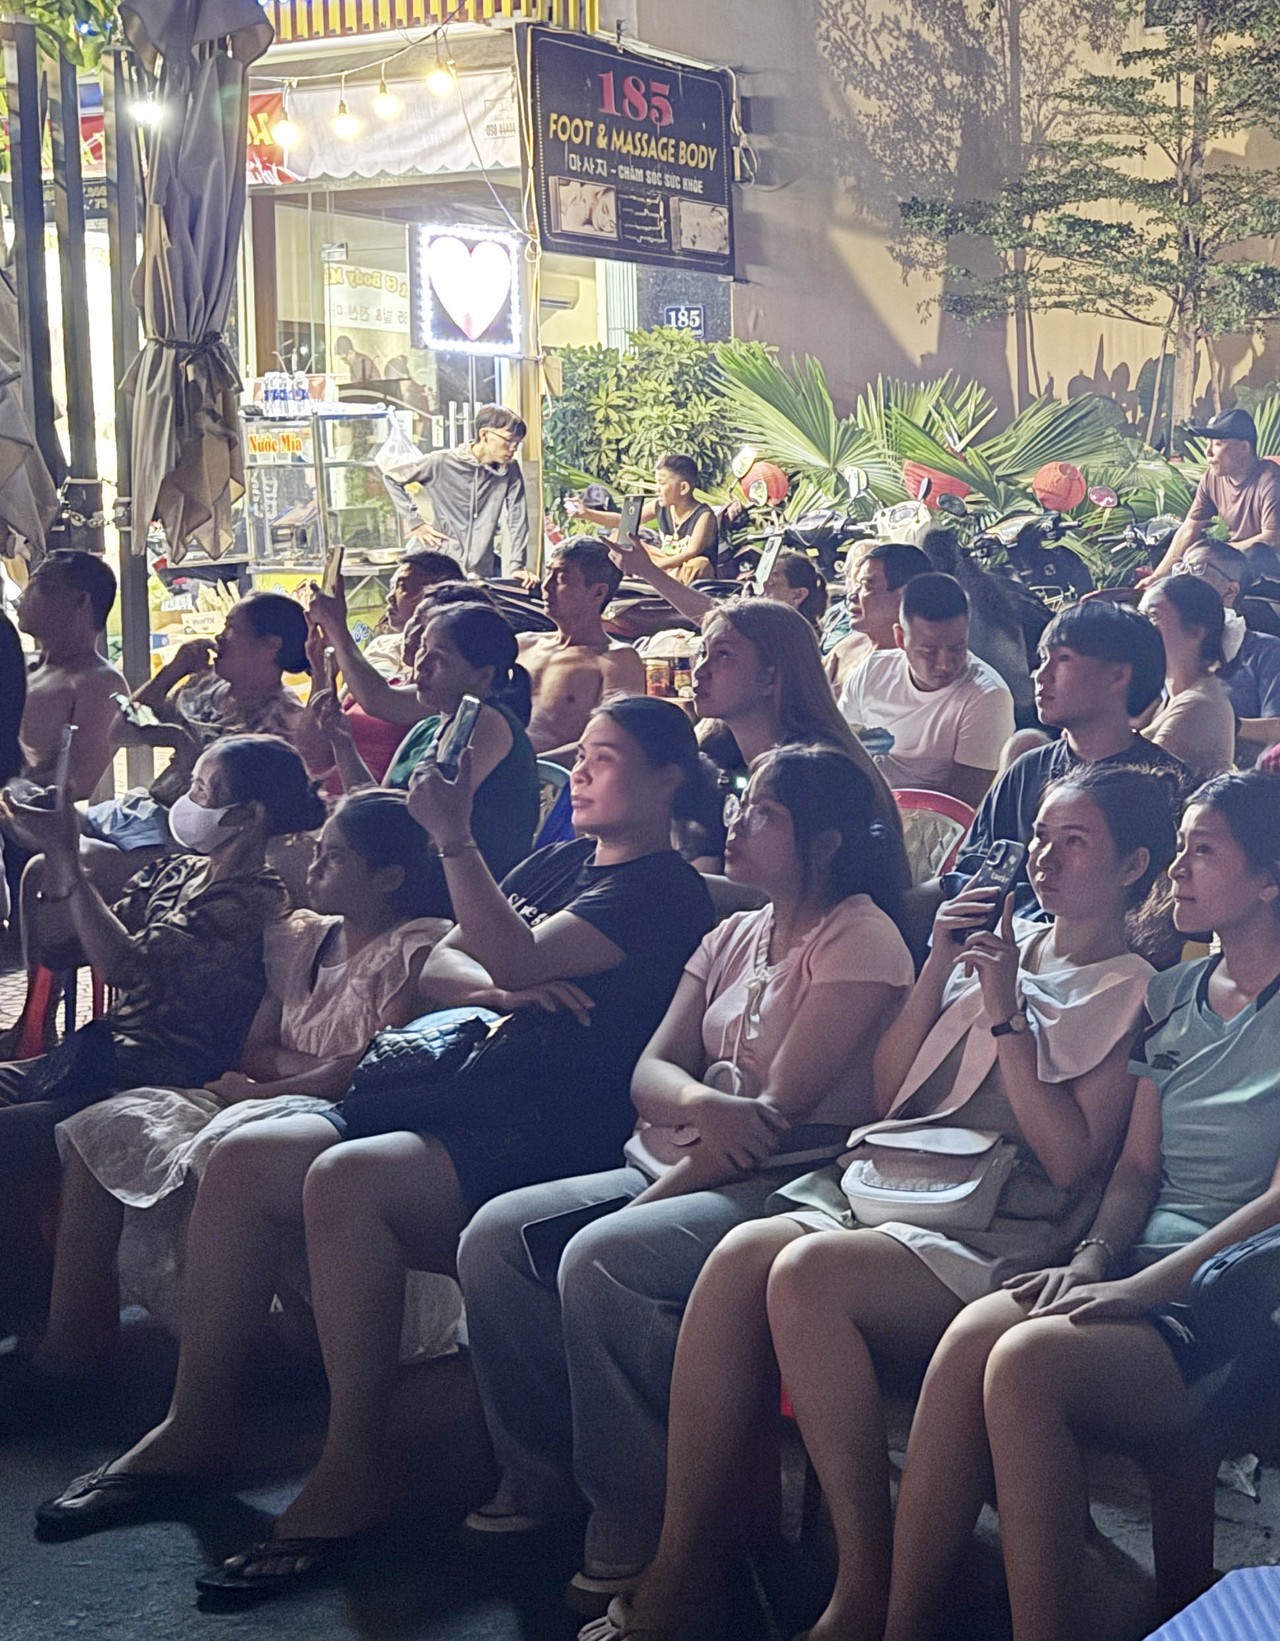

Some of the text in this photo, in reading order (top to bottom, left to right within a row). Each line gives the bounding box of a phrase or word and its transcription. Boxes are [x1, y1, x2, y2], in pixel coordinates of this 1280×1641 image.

[597, 70, 674, 127] 185
[549, 113, 717, 171] FOOT & MASSAGE BODY
[568, 153, 608, 177] 마사지
[668, 310, 701, 328] 185
